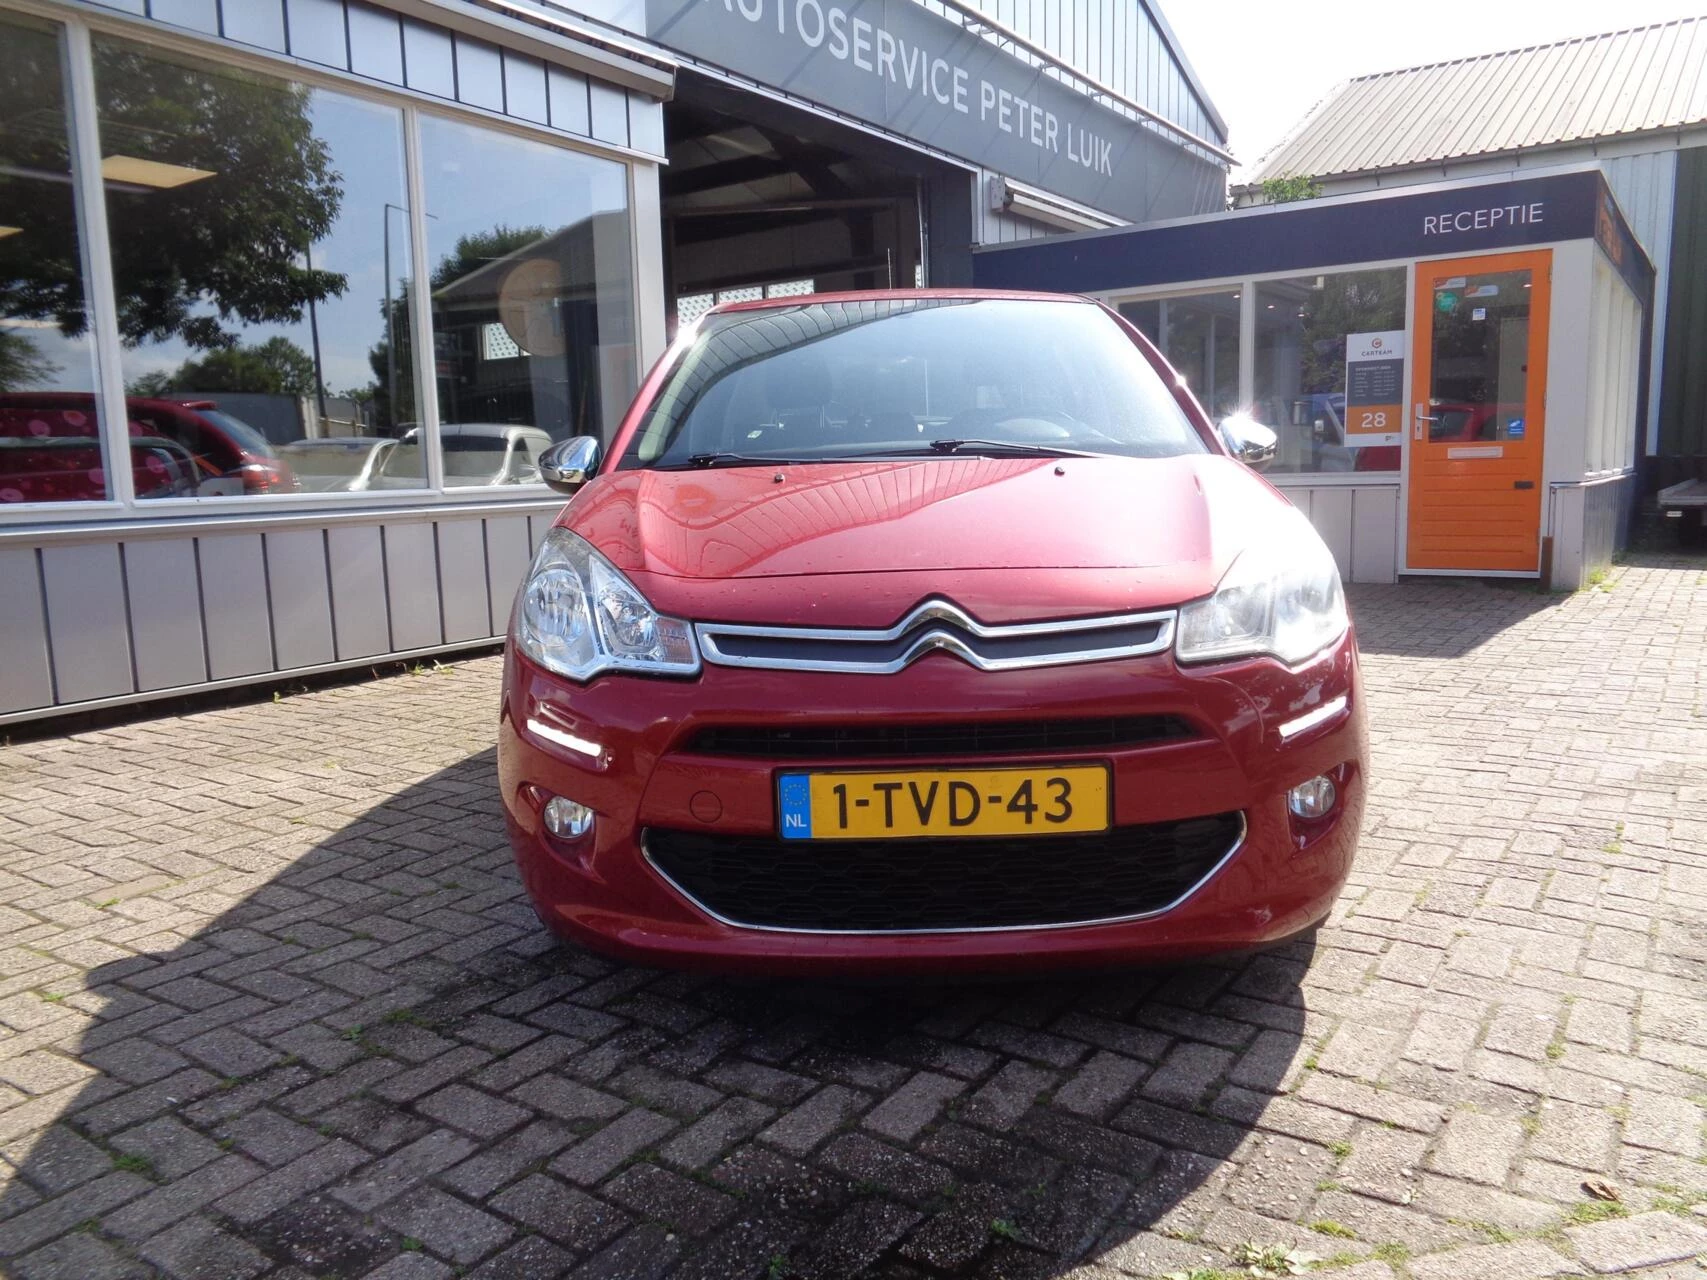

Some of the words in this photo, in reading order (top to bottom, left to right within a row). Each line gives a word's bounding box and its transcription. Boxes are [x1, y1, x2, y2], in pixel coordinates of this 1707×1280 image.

[704, 0, 969, 114] TOSERVICE
[980, 79, 1059, 153] PETER
[1067, 122, 1113, 177] LUIK
[1423, 202, 1544, 235] RECEPTIE
[1361, 411, 1386, 428] 28
[832, 776, 1073, 829] 1-TVD-43
[785, 813, 807, 828] NL
